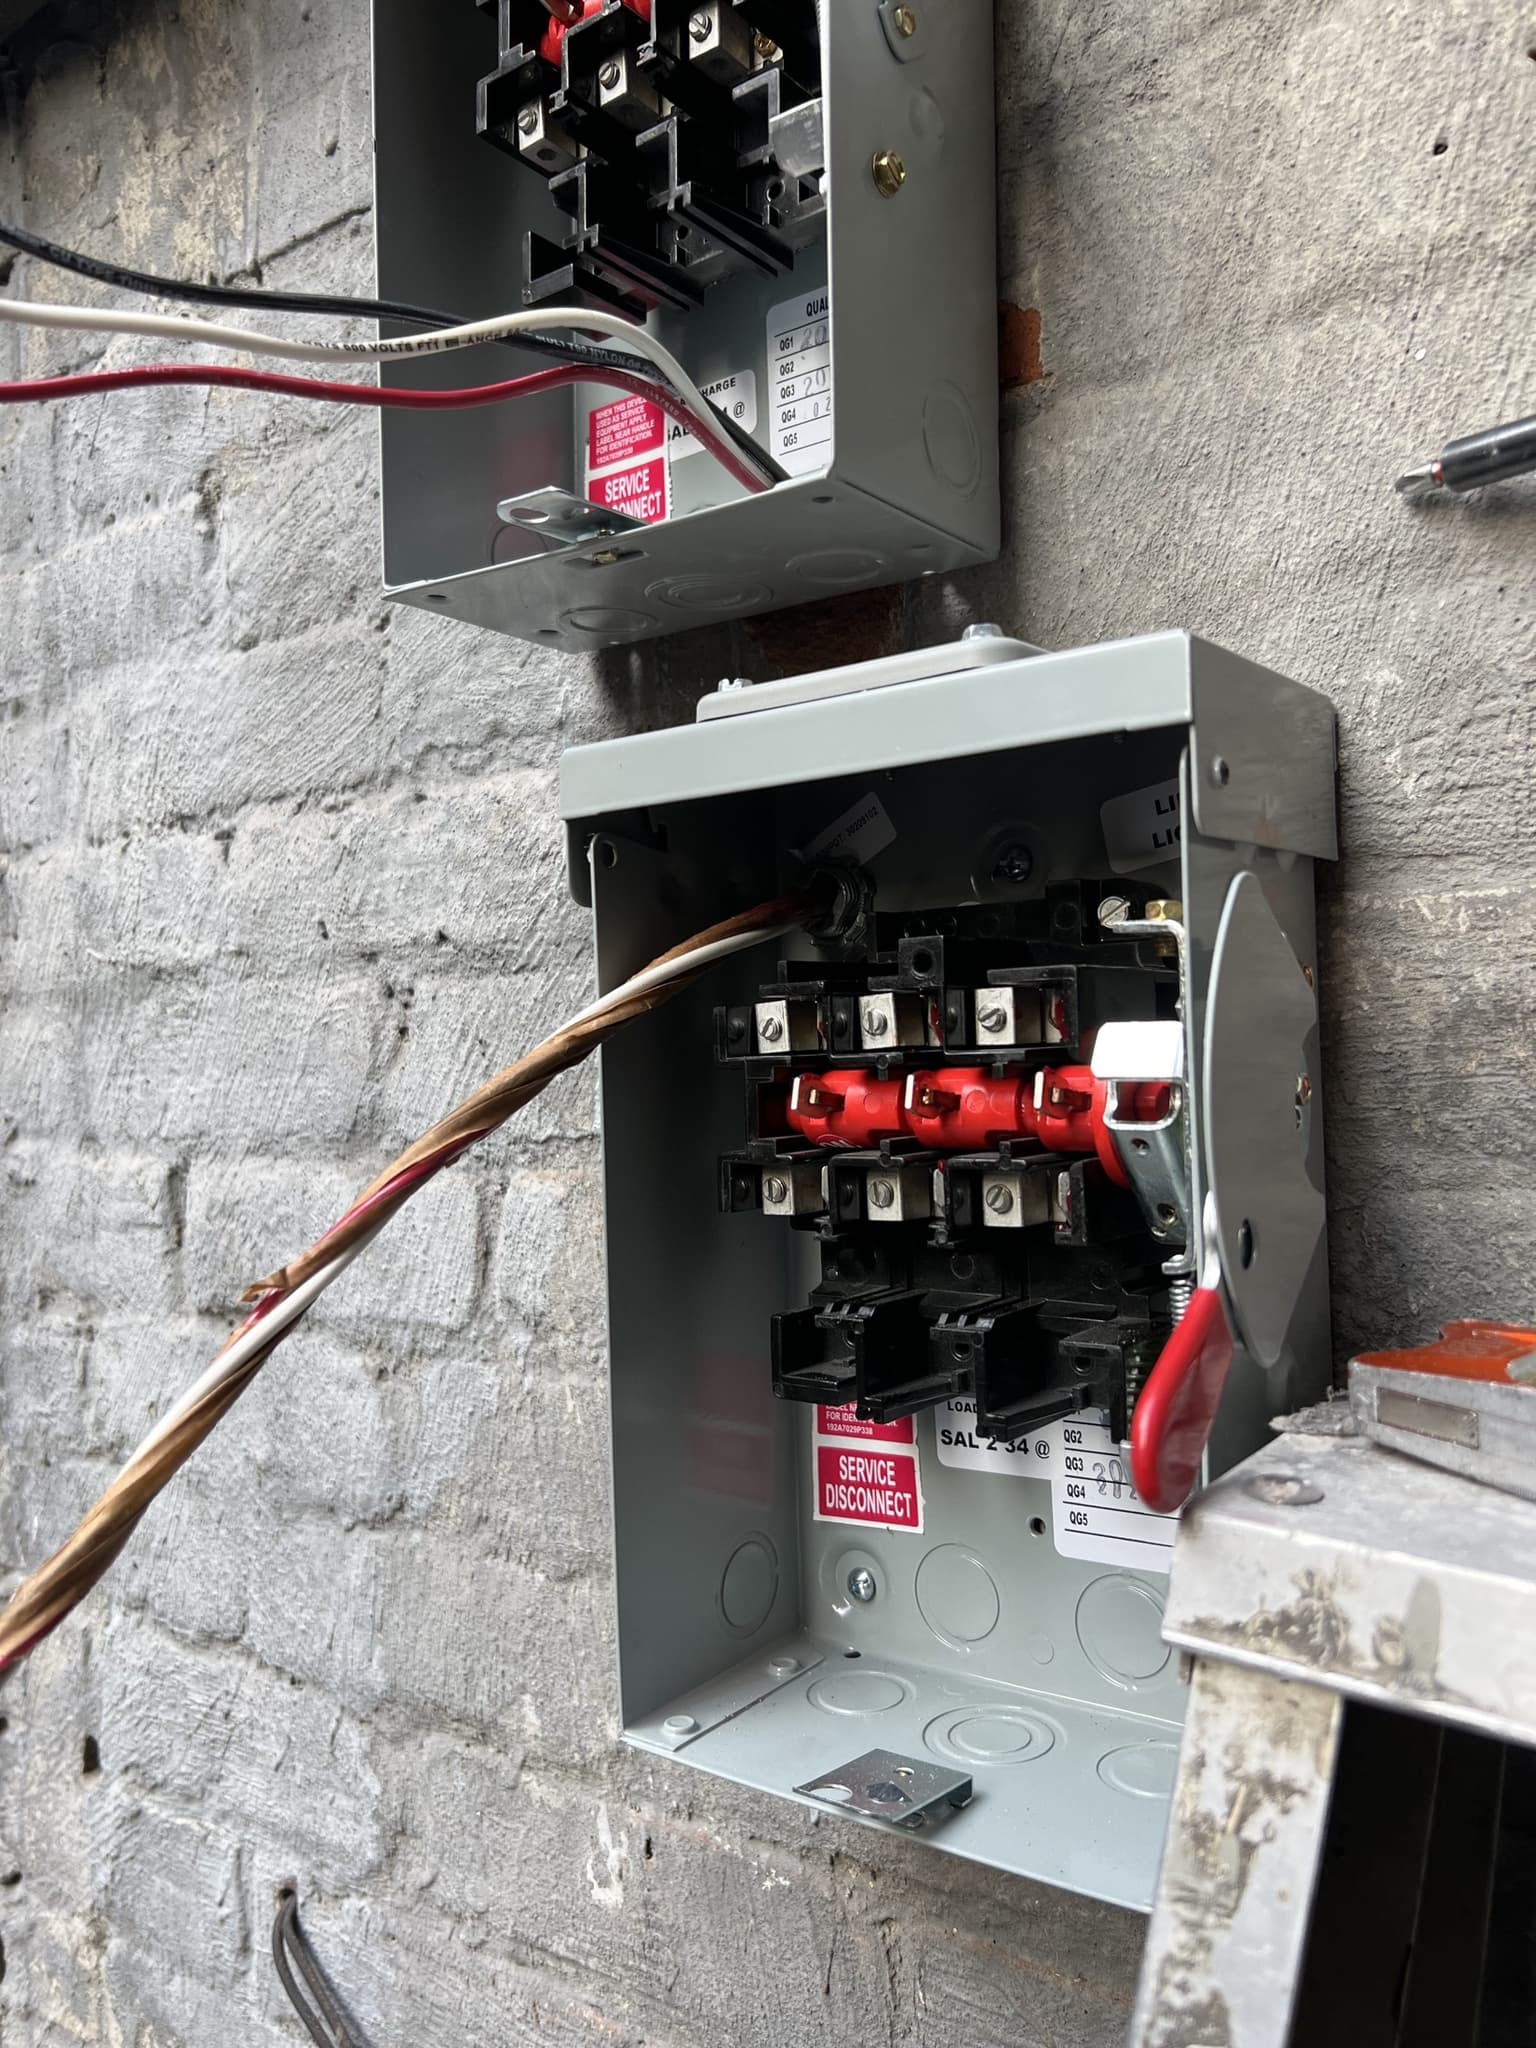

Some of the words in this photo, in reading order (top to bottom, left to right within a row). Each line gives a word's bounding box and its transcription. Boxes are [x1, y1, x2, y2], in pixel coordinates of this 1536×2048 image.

[370, 339, 412, 353] VOLTS
[779, 335, 794, 351] QG1
[590, 348, 626, 365] NYLON
[779, 360, 794, 376] QG2
[781, 383, 795, 400] QG3
[596, 408, 613, 418] WHEN
[614, 402, 628, 413] THIS
[596, 417, 613, 428] USED
[622, 405, 645, 421] SERVICE
[733, 401, 746, 418] @
[782, 406, 796, 423] QG4
[596, 419, 629, 438] EQUIPMENT
[630, 414, 647, 428] APPLY
[596, 432, 614, 447] LABEL
[632, 420, 655, 436] HANDLE
[783, 430, 798, 448] QG5
[596, 443, 609, 456] FOR
[605, 468, 650, 503] SERVICE
[826, 1411, 841, 1423] FOR
[941, 1429, 979, 1448] SAL
[1035, 1440, 1051, 1460] @
[1063, 1429, 1083, 1445] QG2
[839, 1455, 896, 1486] SERVICE
[1065, 1456, 1084, 1472] QG3
[1067, 1483, 1087, 1499] QG4
[825, 1483, 912, 1519] DISCONNECT
[1069, 1510, 1089, 1527] QG5
